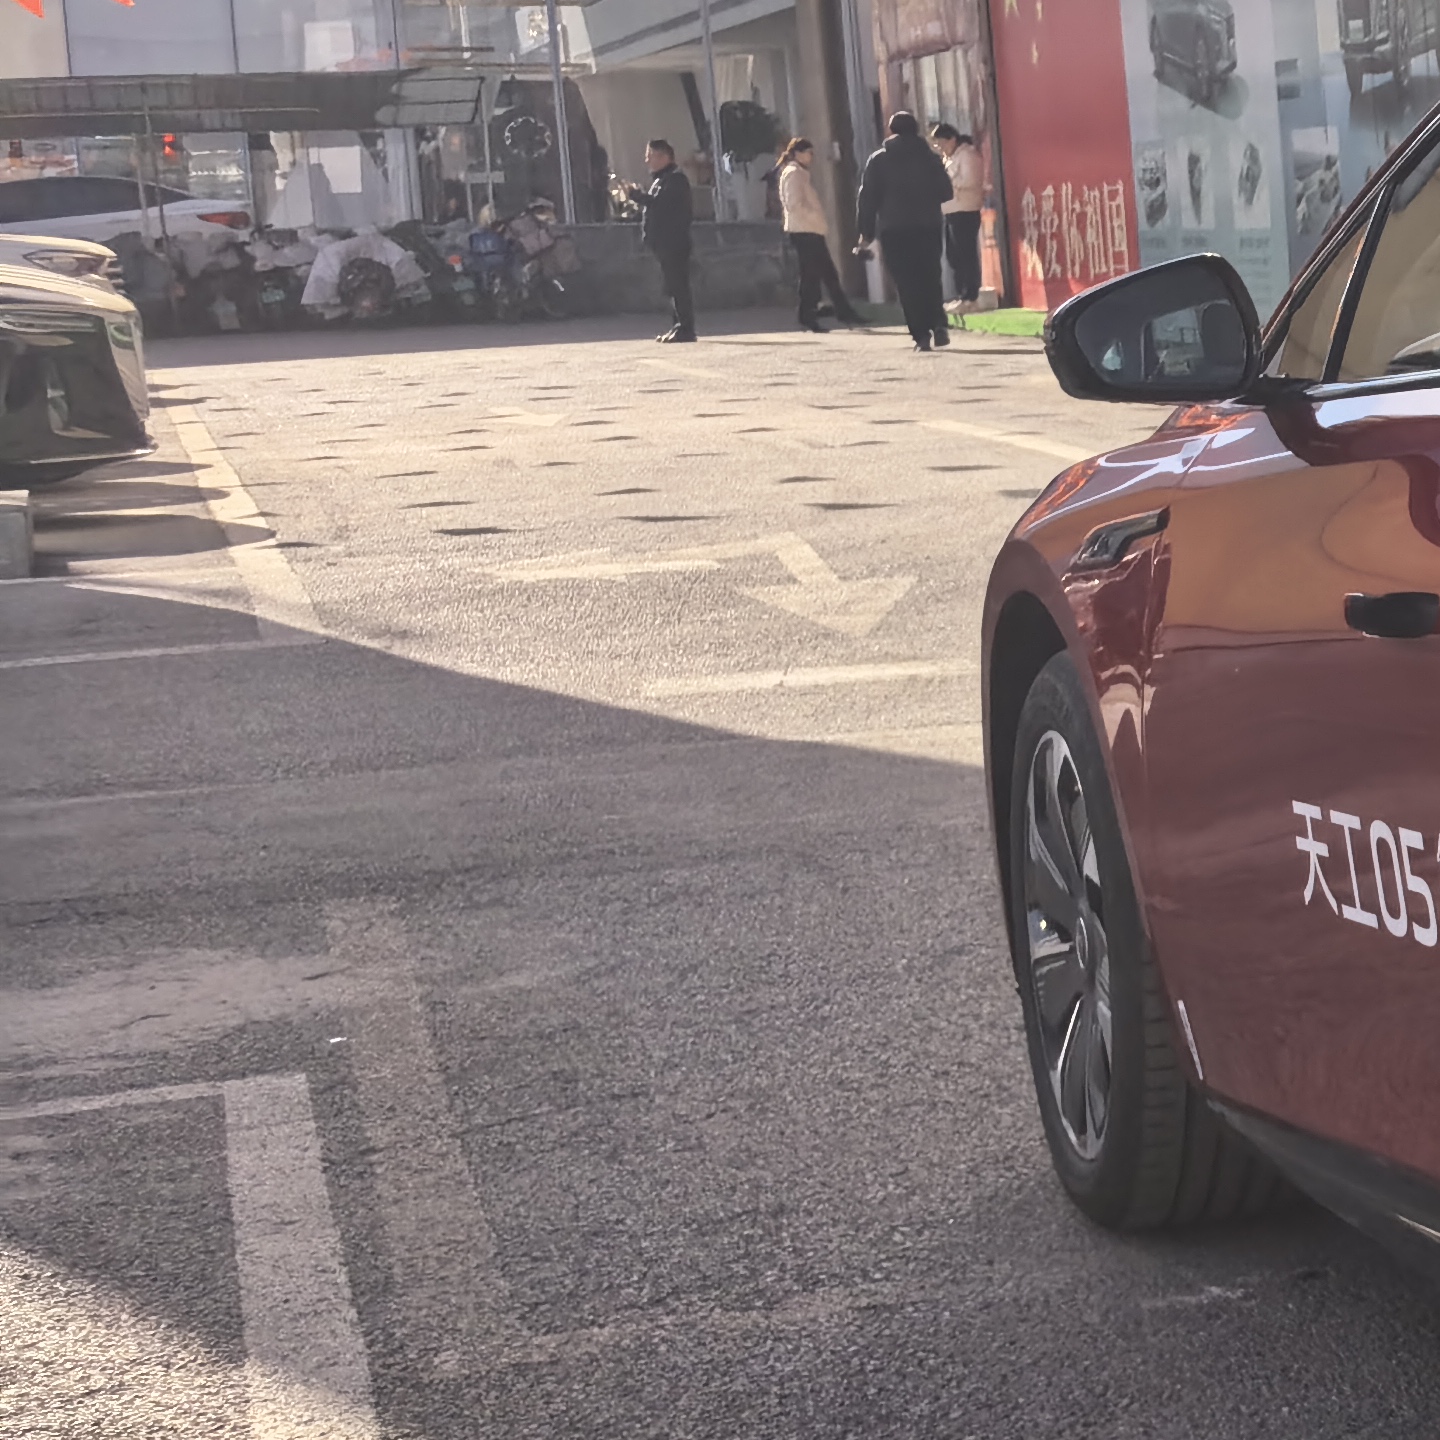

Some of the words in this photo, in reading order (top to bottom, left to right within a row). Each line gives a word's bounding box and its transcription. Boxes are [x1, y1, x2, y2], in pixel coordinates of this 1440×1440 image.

[1021, 179, 1131, 282] 我爱你祖国
[1291, 799, 1439, 948] 天工05
